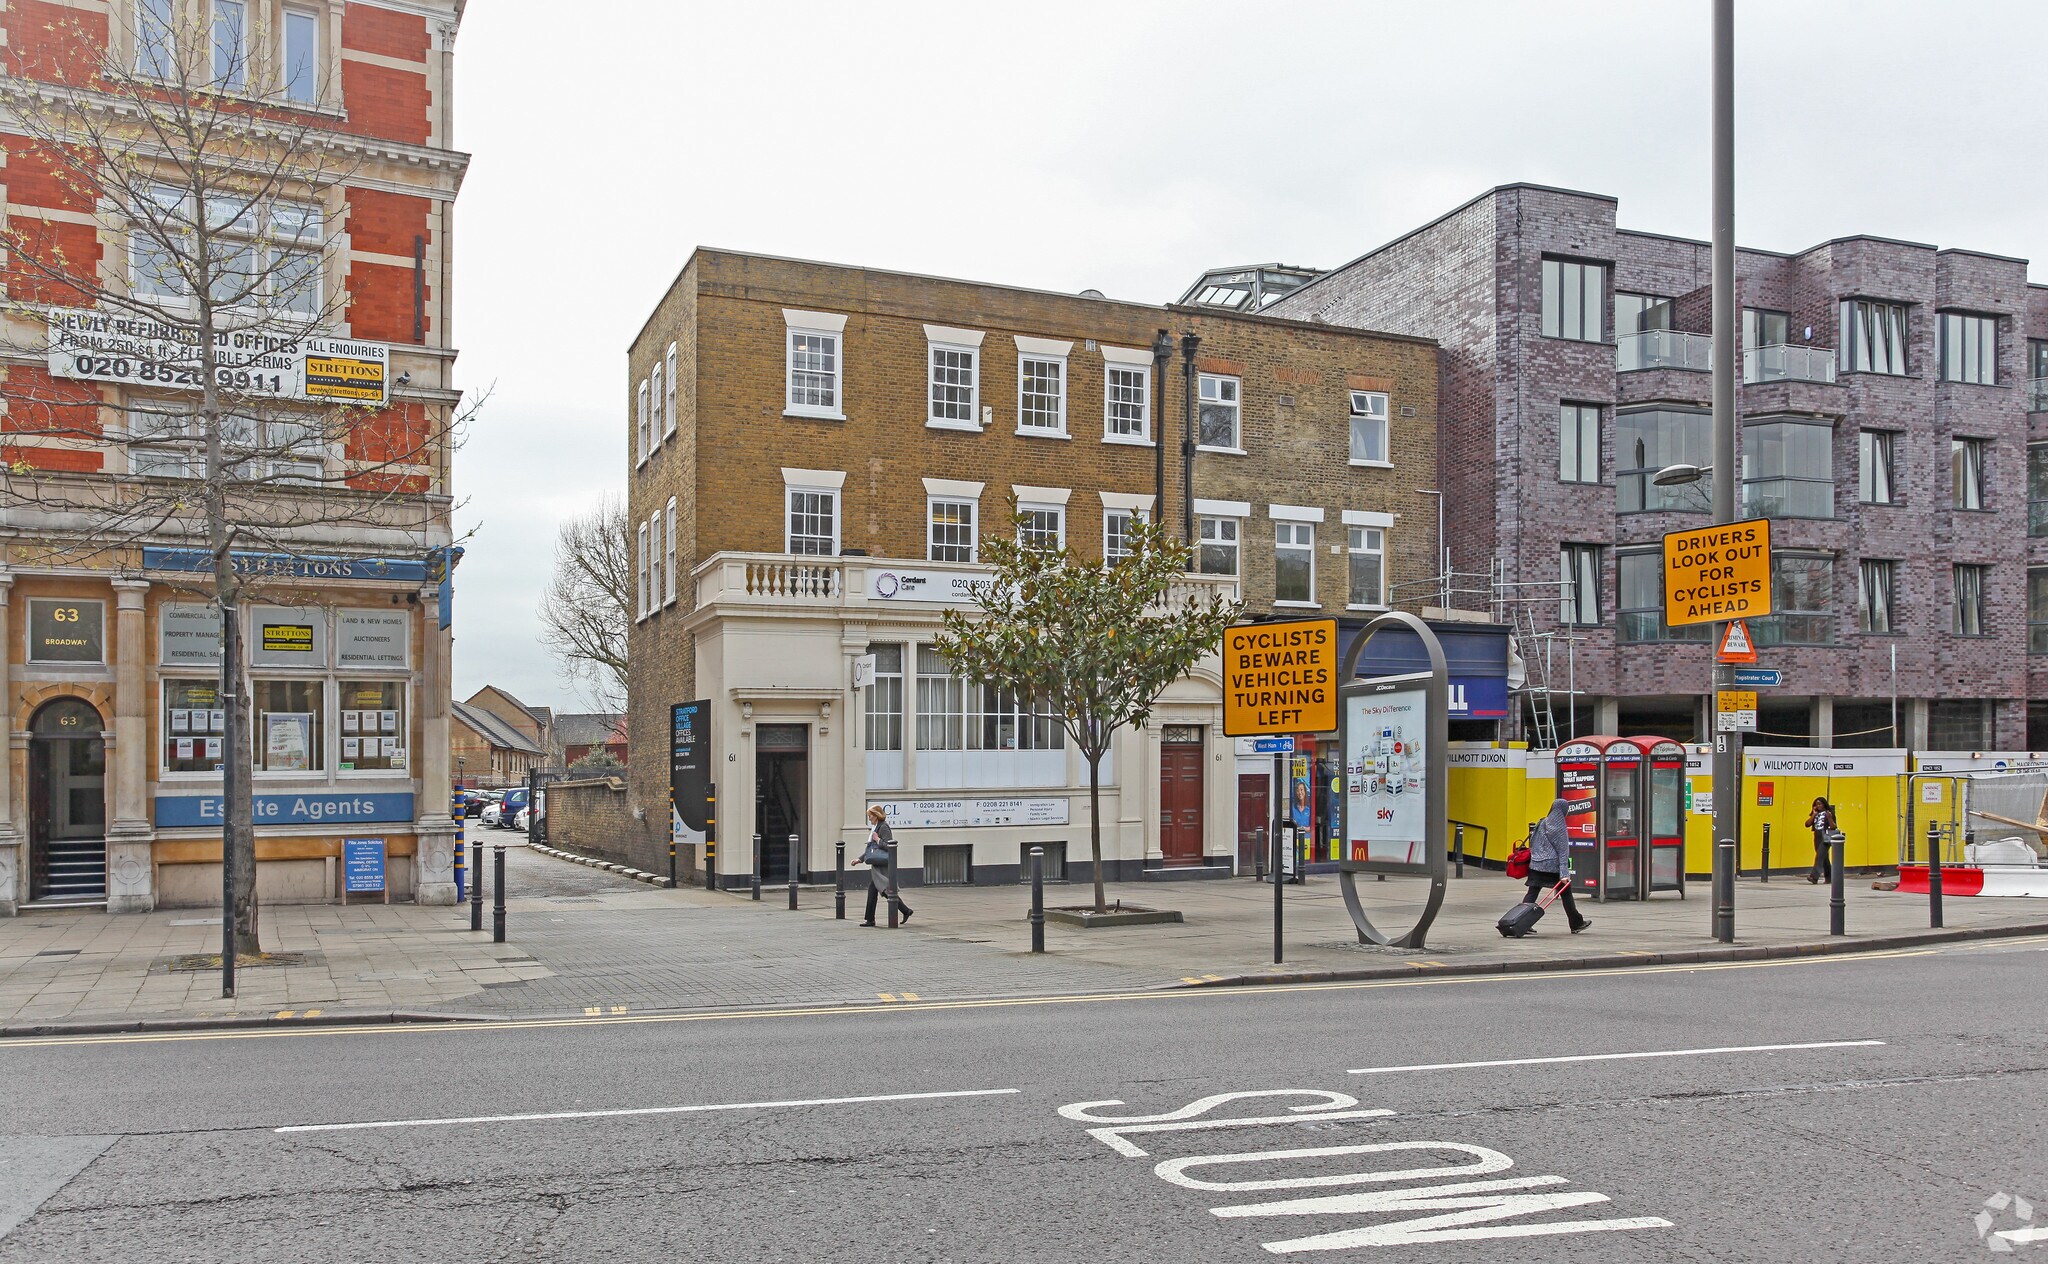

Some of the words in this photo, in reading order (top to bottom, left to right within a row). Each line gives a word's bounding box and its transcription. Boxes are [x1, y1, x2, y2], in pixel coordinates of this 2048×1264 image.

[54, 312, 109, 333] NEWLY
[116, 319, 229, 348] REFURBISED
[234, 333, 298, 355] OFFICES
[60, 333, 102, 348] FROM
[108, 339, 133, 352] 250
[181, 347, 242, 365] FLEIBLE
[247, 353, 292, 370] TERMS
[306, 340, 326, 352] ALL
[329, 342, 384, 358] ENQUIRIES
[76, 355, 130, 378] 020
[217, 369, 281, 393] 9911
[310, 362, 380, 377] STRETTONS
[1677, 529, 1756, 552] DRIVERS
[1672, 551, 1719, 569] LOOK
[1725, 545, 1762, 561] OUT
[900, 576, 926, 584] Cordant
[1699, 566, 1734, 582] FOR
[952, 579, 968, 588] 020
[1674, 580, 1761, 602] CYCLISTS
[54, 608, 79, 622] 63
[1687, 599, 1749, 618] AHEAD
[45, 638, 88, 646] BROADWAY
[1233, 629, 1326, 650] CYCLISTS
[1240, 649, 1320, 669] BEWARE
[1232, 668, 1327, 688] VEHICLES
[1235, 688, 1325, 708] TURNING
[1448, 684, 1468, 710] LL
[675, 706, 698, 716] STRATFORD
[1258, 709, 1302, 726] LEFT
[1372, 706, 1382, 715] Sky
[1383, 705, 1412, 713] Difference
[60, 716, 77, 726] 63
[675, 715, 690, 723] OFFICE
[675, 722, 692, 730] VILLAGE
[675, 729, 691, 737] OFFICES
[675, 735, 696, 744] AVAILABLE
[728, 753, 736, 762] 61
[1448, 754, 1480, 762] ILLMOTT
[1481, 754, 1506, 762] DIXON
[1763, 760, 1802, 770] WILLMOTT
[1803, 762, 1828, 770] DIXON
[200, 799, 279, 818] Este
[291, 797, 375, 820] Agents
[1377, 807, 1394, 822] sky
[1057, 1088, 1675, 1254] SLOW
